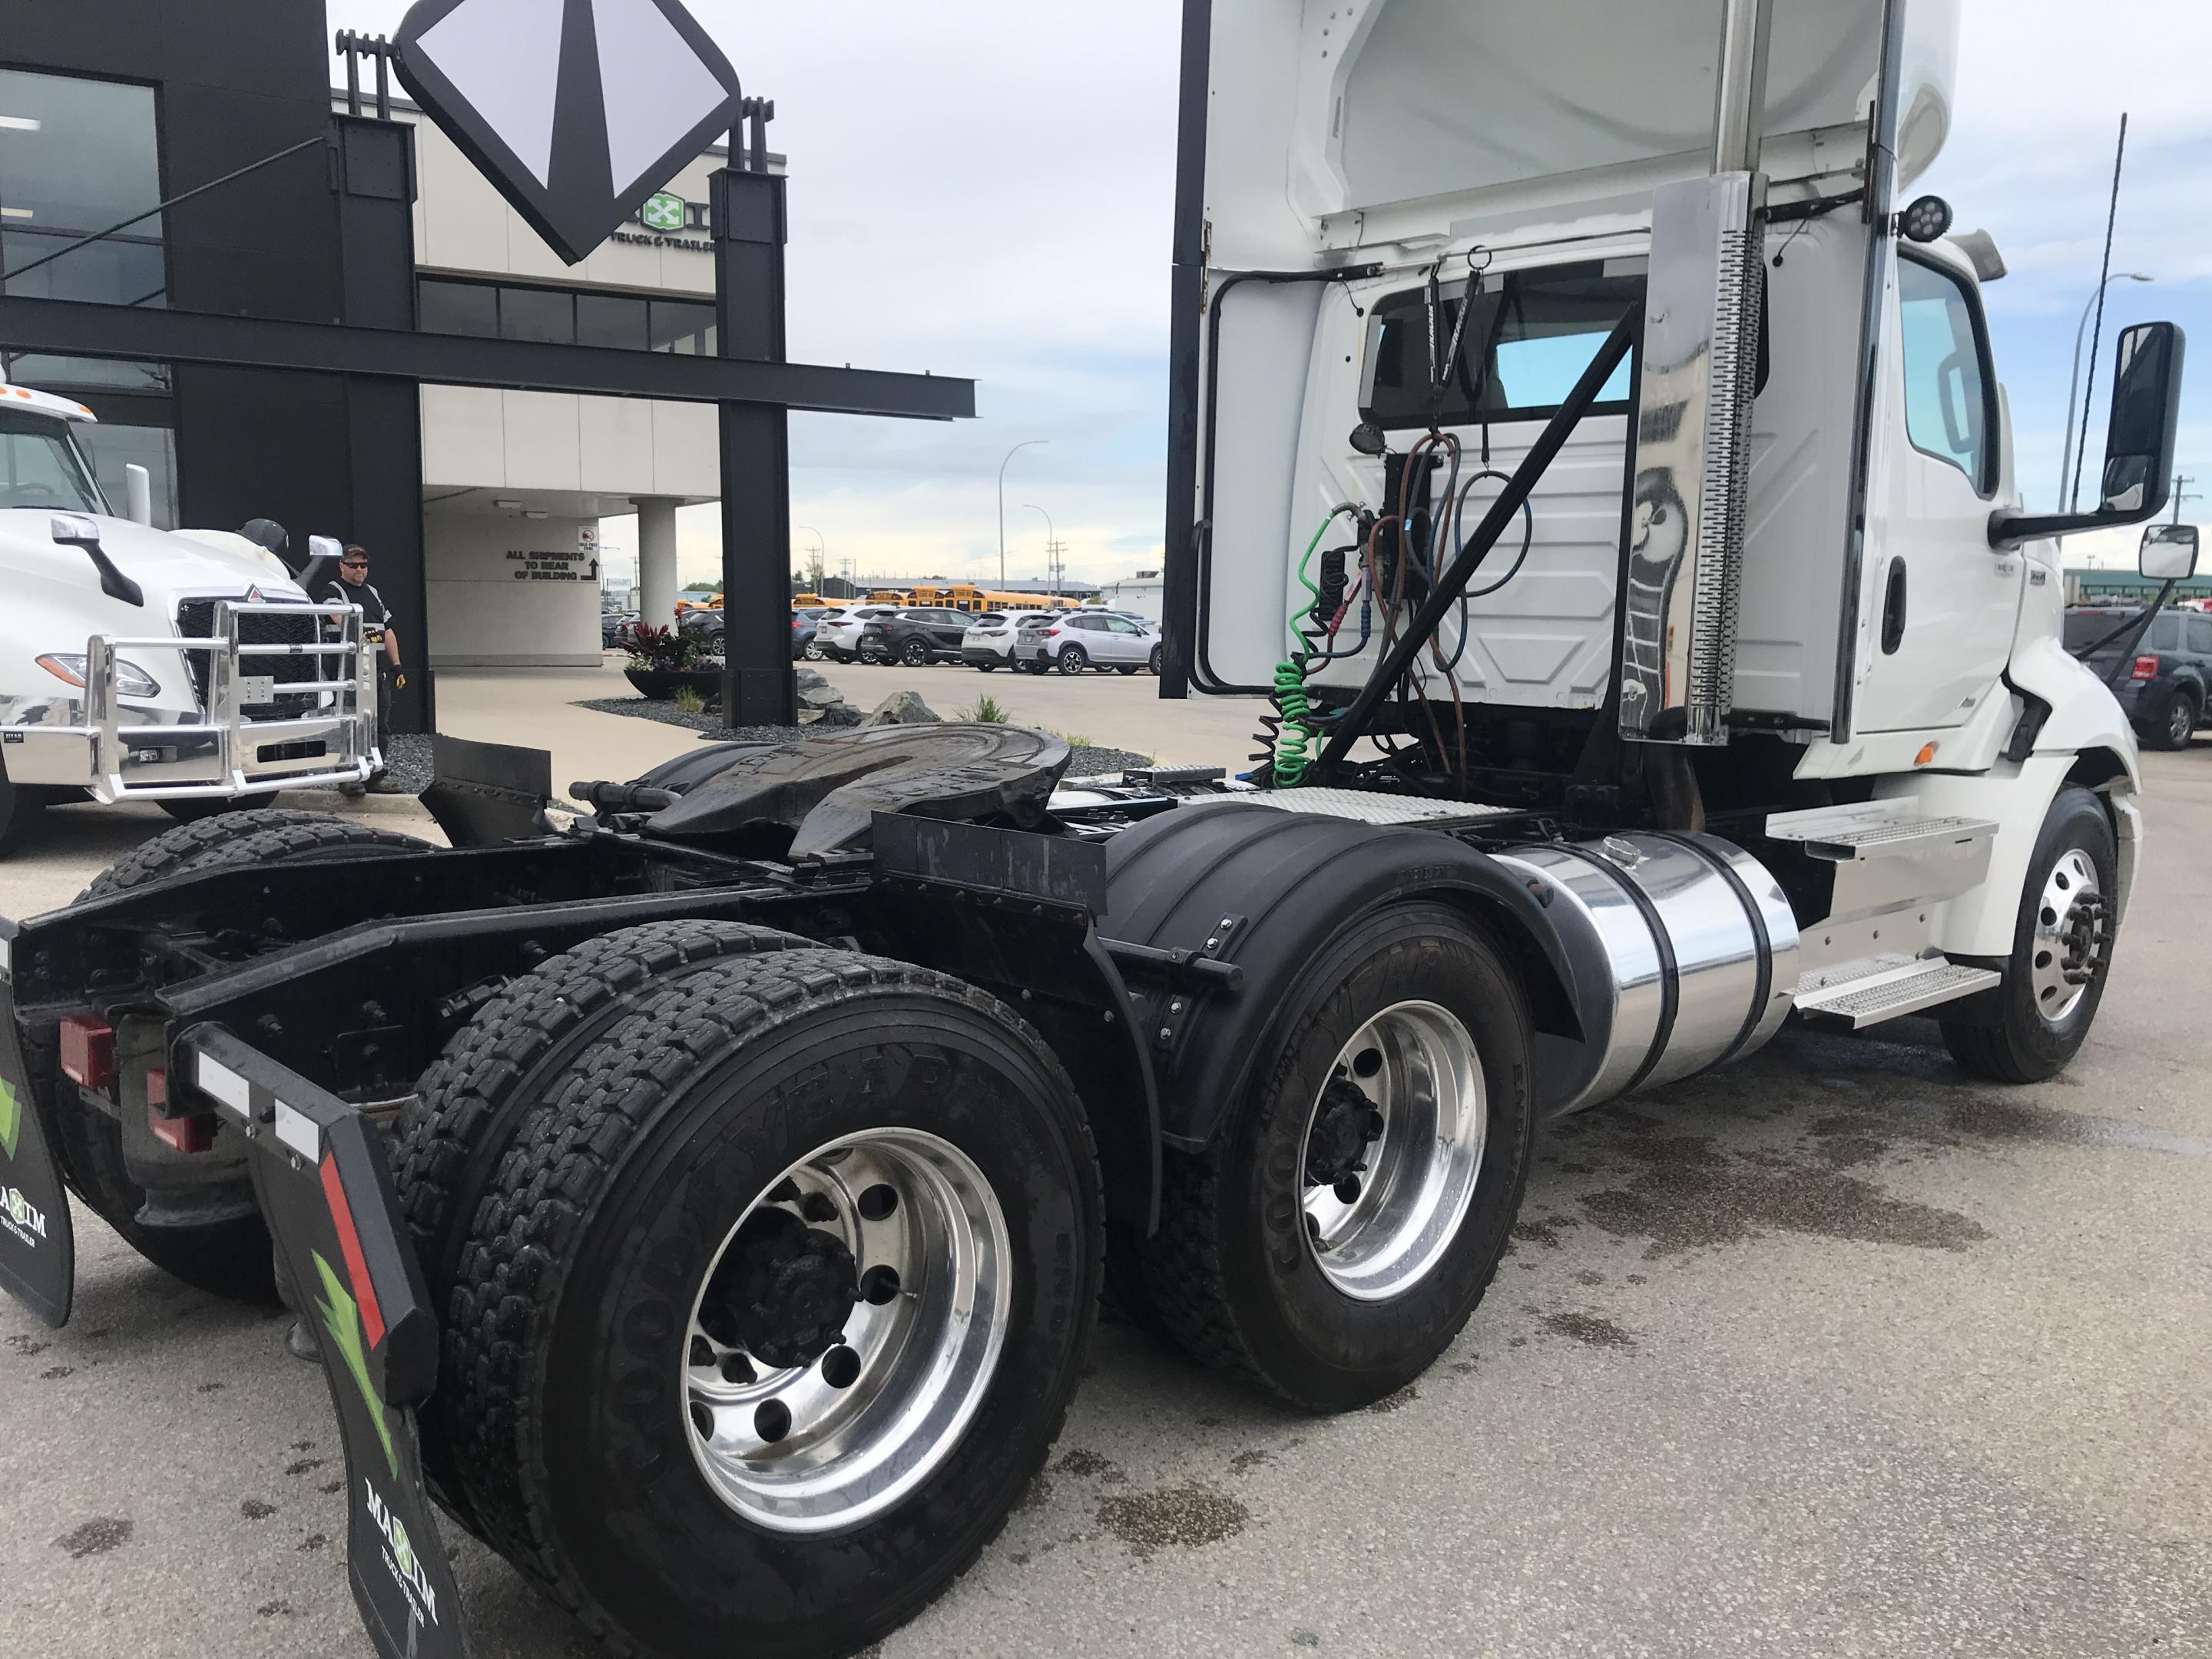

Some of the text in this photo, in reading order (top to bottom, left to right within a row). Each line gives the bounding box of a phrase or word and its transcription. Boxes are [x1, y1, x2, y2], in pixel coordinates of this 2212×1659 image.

[611, 231, 653, 246] TRUCK
[506, 551, 584, 561] ALL SHIPMENTS
[525, 561, 569, 570] TO REAR
[515, 571, 578, 580] OF BUILDING
[0, 1186, 47, 1238] AXIM
[18, 1227, 35, 1248] TRAILER
[365, 1476, 439, 1626] MAXIM
[382, 1545, 399, 1582] TRUCK
[402, 1580, 424, 1628] TRAILER
